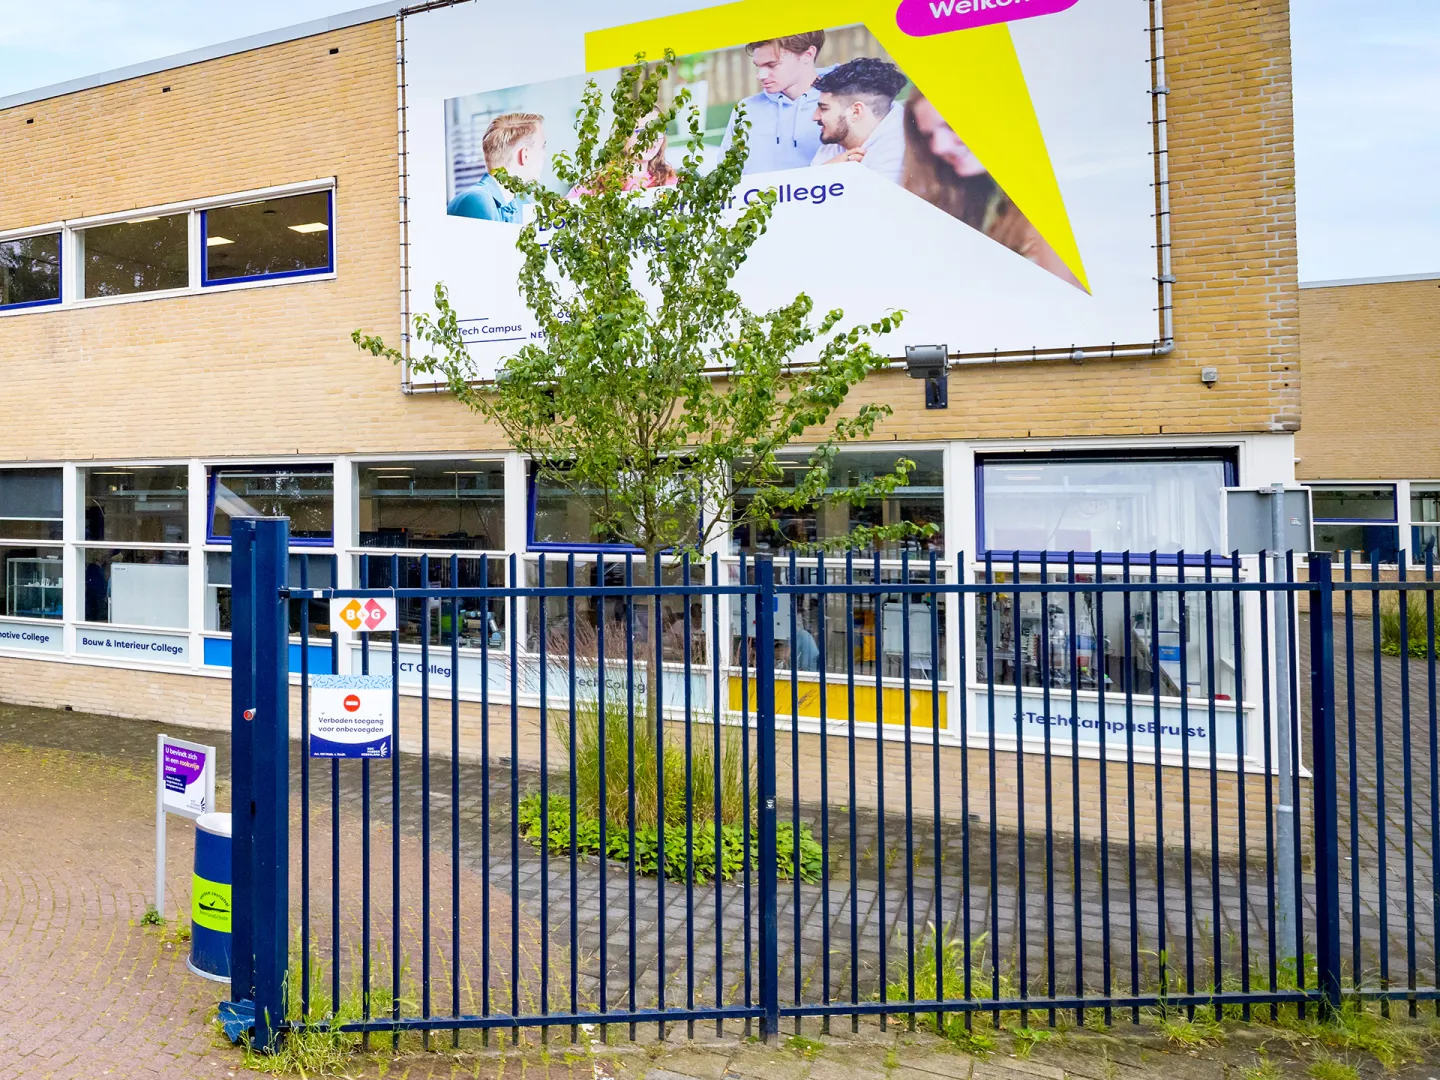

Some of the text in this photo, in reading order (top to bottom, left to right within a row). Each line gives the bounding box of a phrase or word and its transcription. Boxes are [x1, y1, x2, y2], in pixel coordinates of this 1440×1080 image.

[929, 0, 1032, 19] Welko
[743, 183, 845, 205] Cllege
[458, 324, 522, 336] Tech Campus
[21, 632, 50, 643] College
[82, 637, 183, 655] Bouw & Interieur College
[400, 662, 451, 678] CT Clleg
[354, 717, 384, 725] toegang
[336, 725, 384, 734] onbevoegden
[170, 748, 187, 758] bevindt
[170, 757, 180, 765] een
[165, 765, 177, 773] zone
